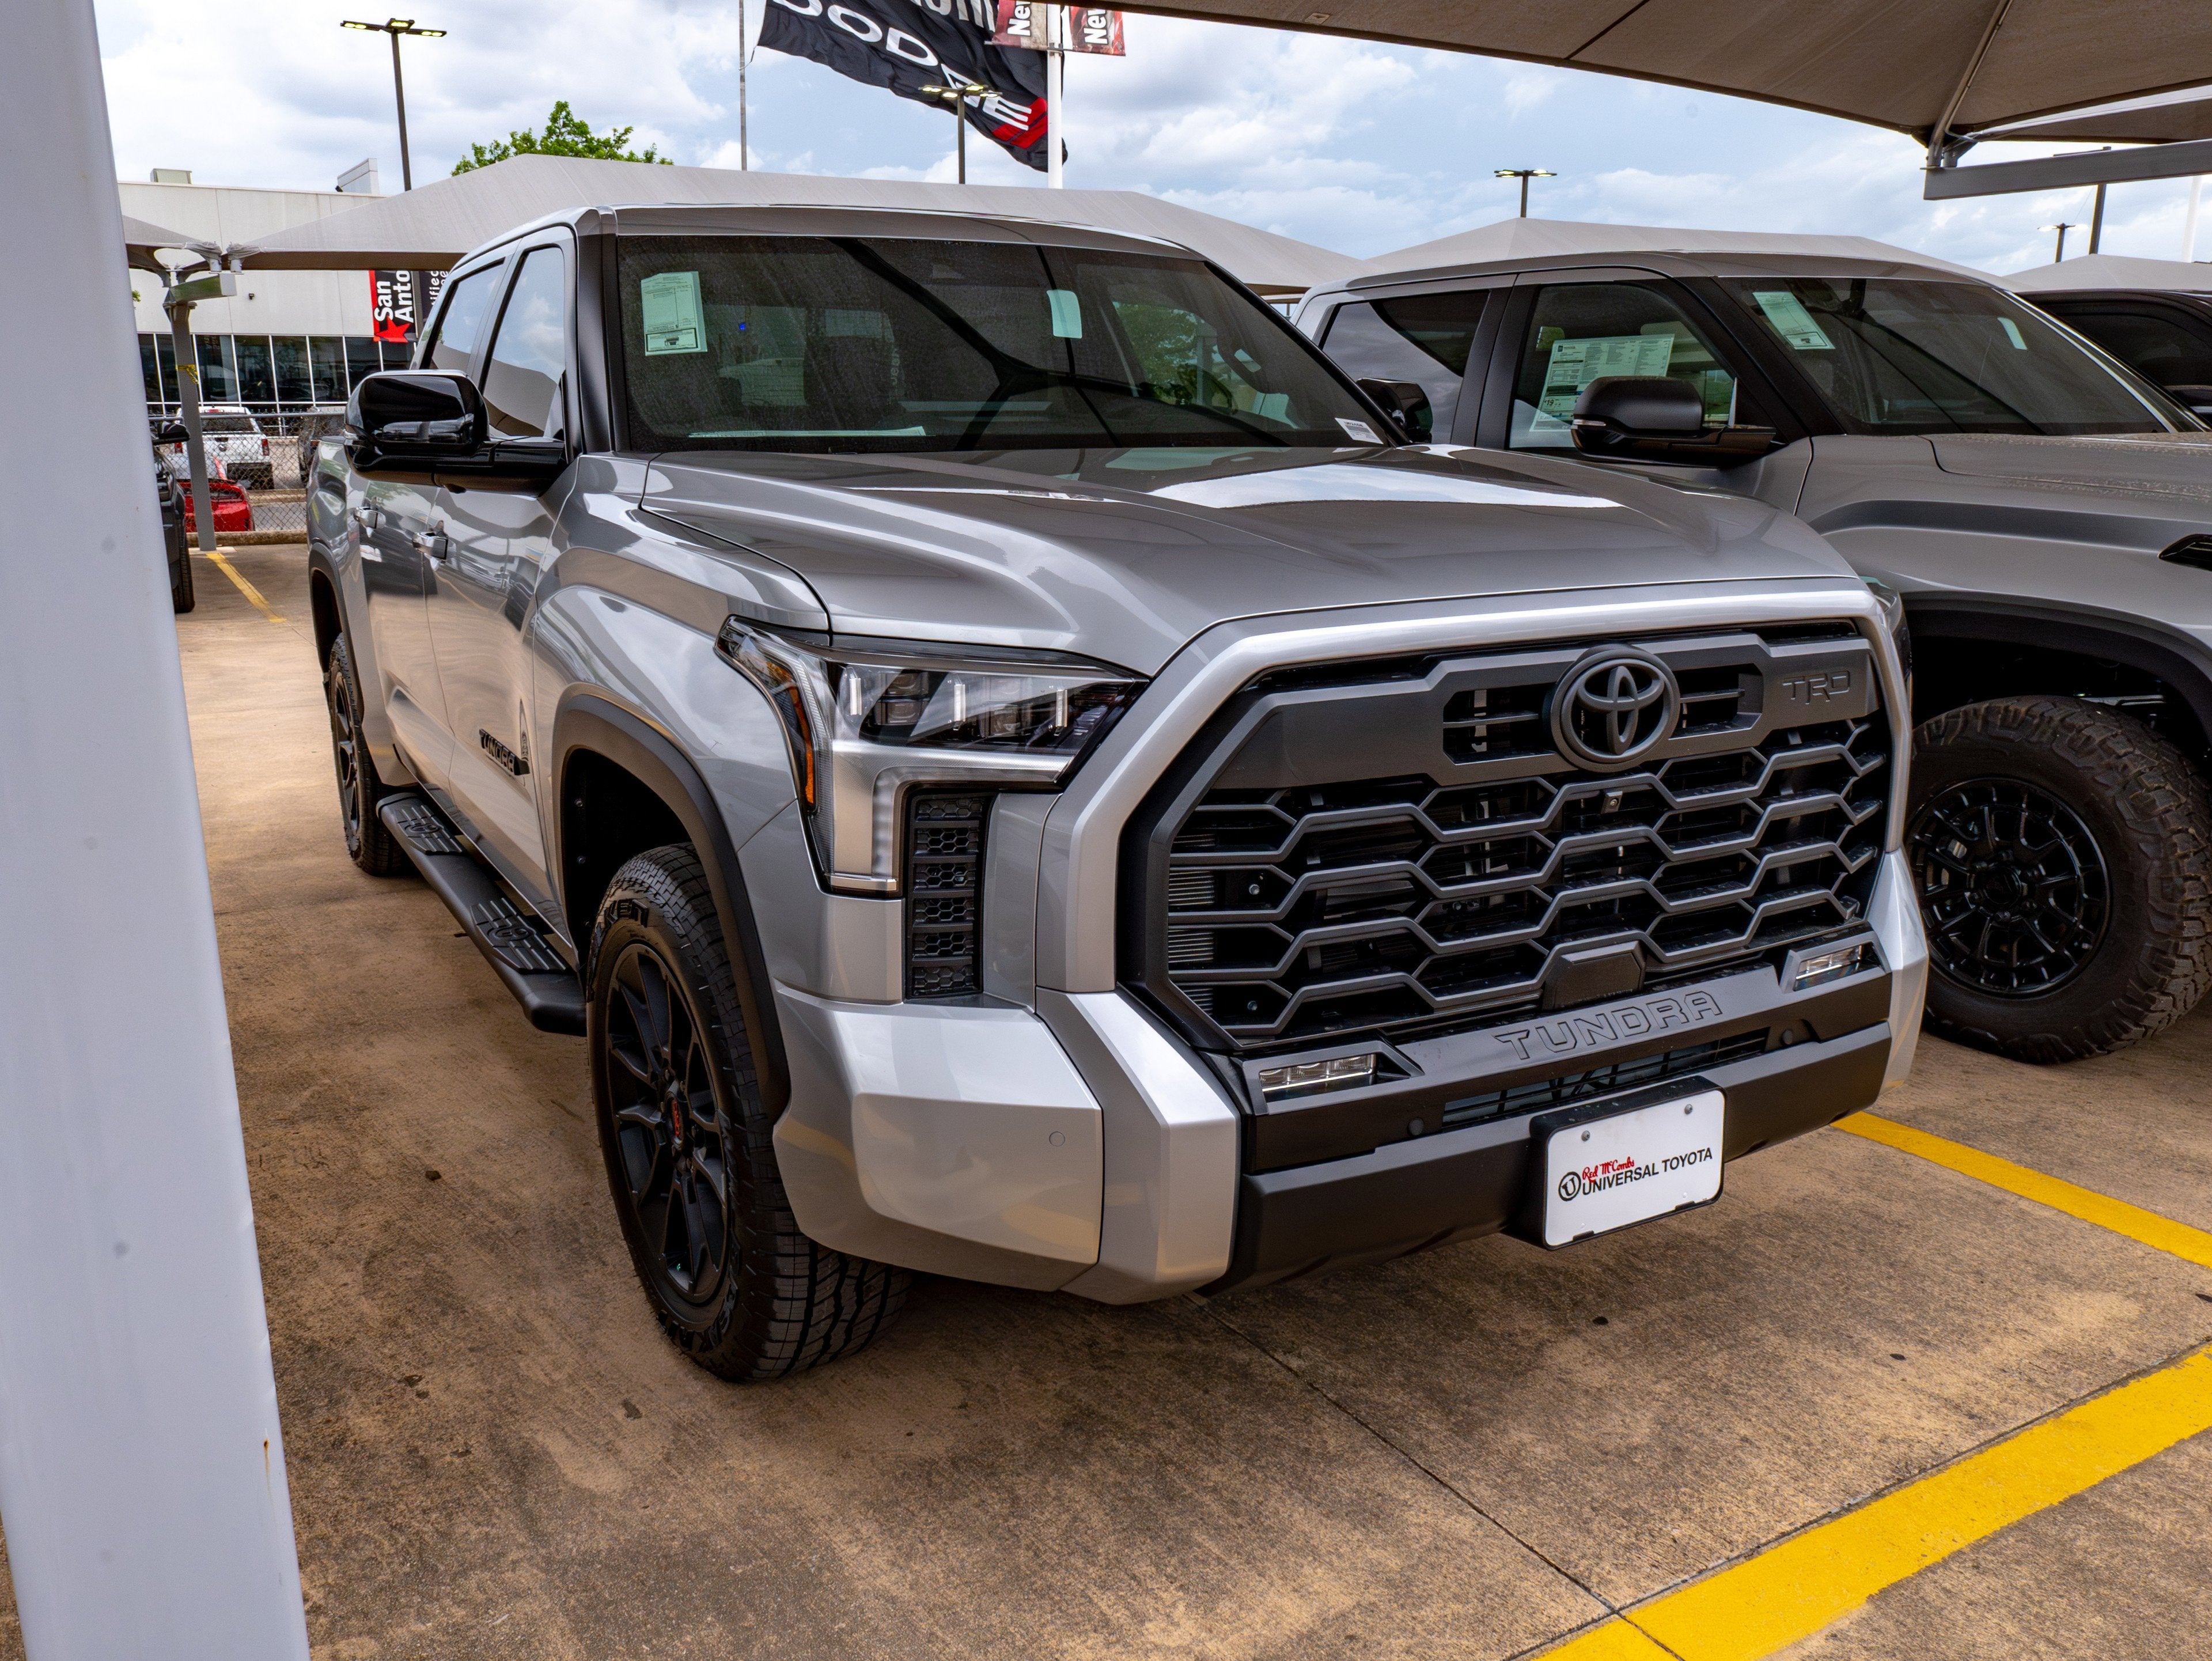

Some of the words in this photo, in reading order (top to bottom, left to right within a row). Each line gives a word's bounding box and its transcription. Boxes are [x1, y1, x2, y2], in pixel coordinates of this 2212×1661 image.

[374, 281, 393, 321] San
[1782, 670, 1850, 705] TRD
[1494, 990, 1723, 1060] TUNDRA
[1582, 1165, 1599, 1183] Red
[1600, 1156, 1635, 1174] McCombs
[1582, 1163, 1660, 1195] UNIVERSAL
[1661, 1147, 1713, 1172] TOYOTA
